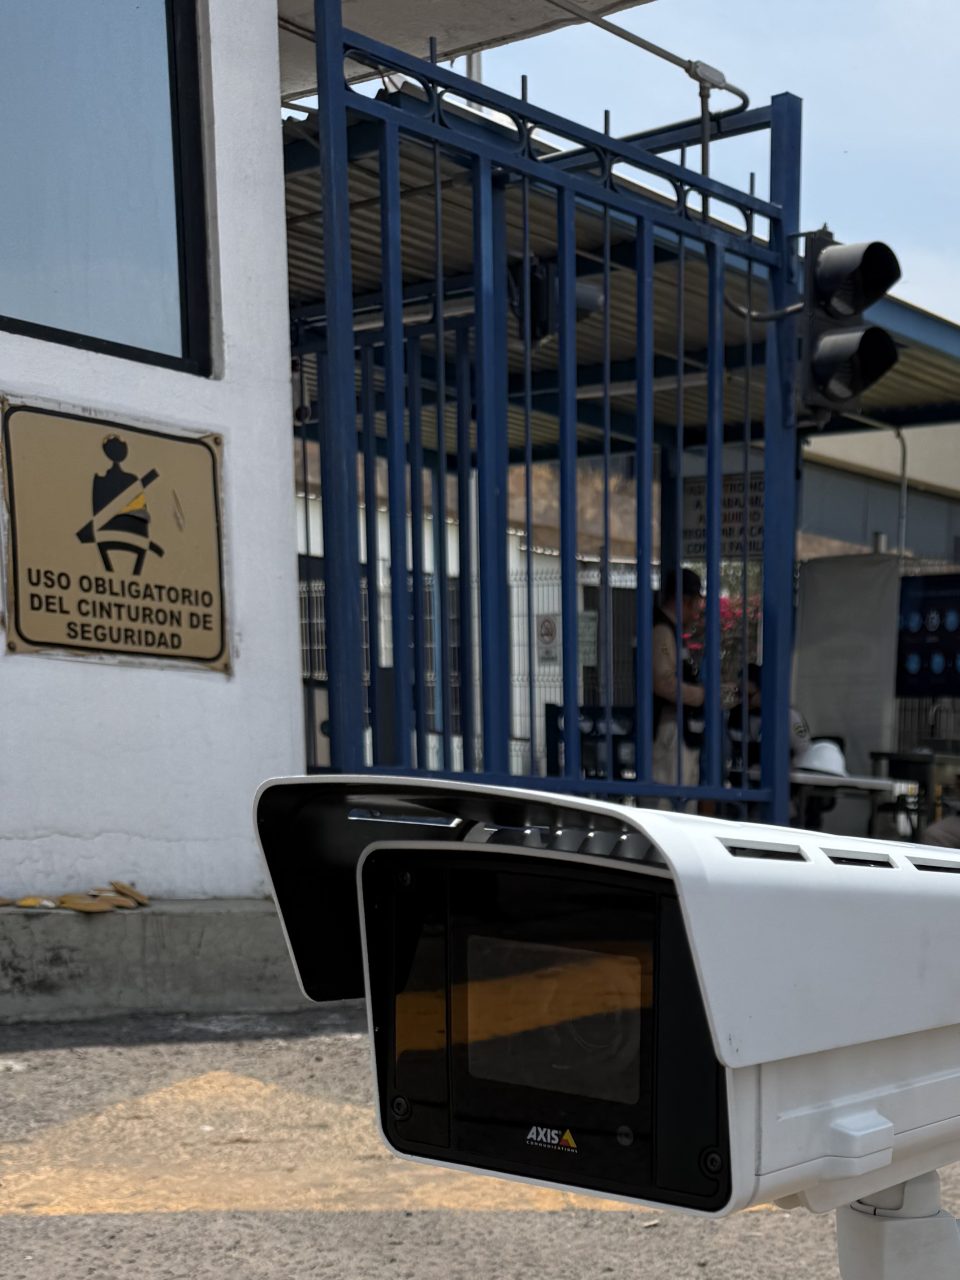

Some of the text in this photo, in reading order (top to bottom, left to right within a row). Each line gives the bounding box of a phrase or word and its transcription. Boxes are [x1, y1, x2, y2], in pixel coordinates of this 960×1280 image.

[27, 567, 213, 608] USO OBLIGATORIO
[30, 593, 213, 631] DEL CINTURON DE
[66, 621, 182, 650] SEGURIDAD
[526, 1125, 559, 1144] AXIS
